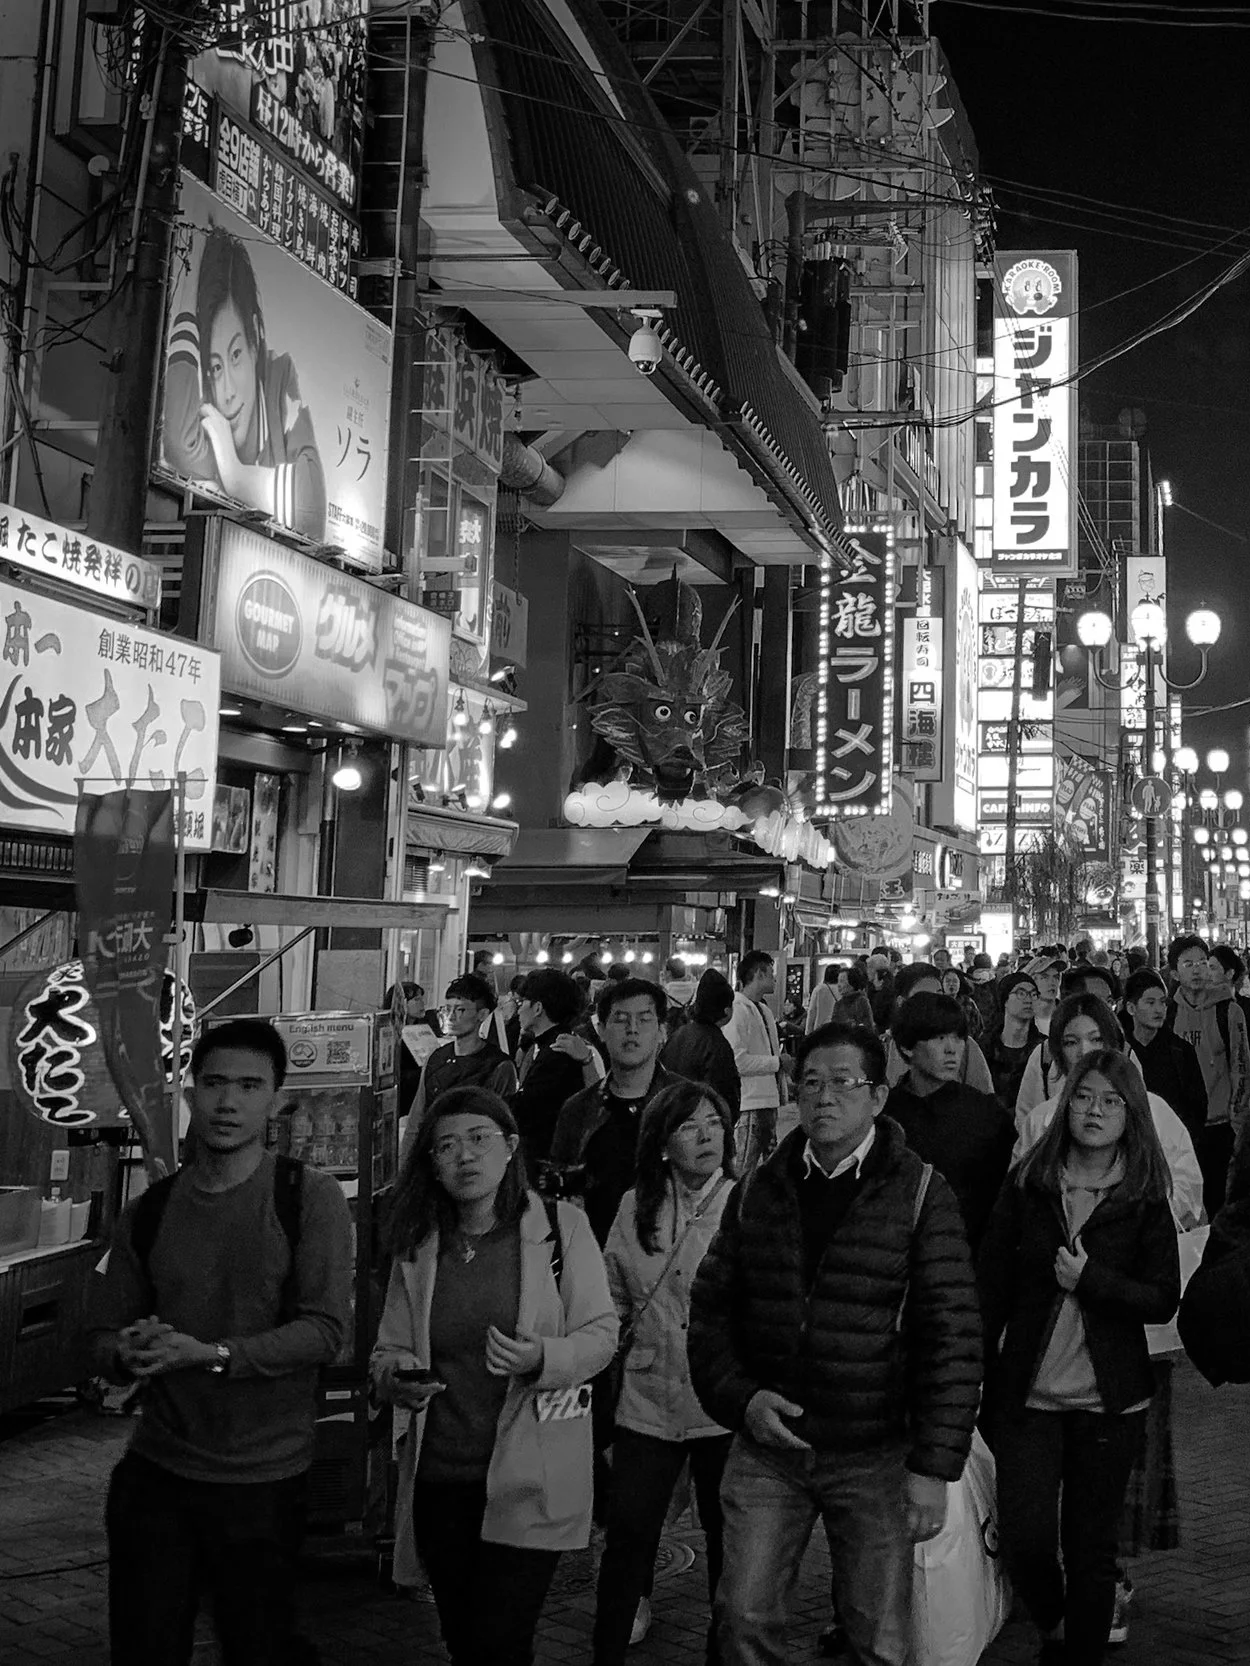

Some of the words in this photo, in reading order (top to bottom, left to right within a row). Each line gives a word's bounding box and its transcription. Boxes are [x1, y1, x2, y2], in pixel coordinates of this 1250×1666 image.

[259, 154, 273, 231] からあげ
[271, 162, 285, 242] 韓国料理
[284, 175, 296, 248] イタリアン
[336, 425, 372, 482] ソラ
[1009, 325, 1053, 545] ジャンカラ
[244, 599, 295, 635] GOURMET
[256, 628, 281, 654] MAP
[316, 591, 378, 665] グルメ
[914, 619, 931, 668] 回転寿司
[97, 628, 203, 685] 創業昭和47年
[829, 538, 883, 802] 金龍ラーメン
[12, 686, 77, 766] 本家
[288, 1023, 325, 1035] English
[327, 1022, 354, 1034] menu
